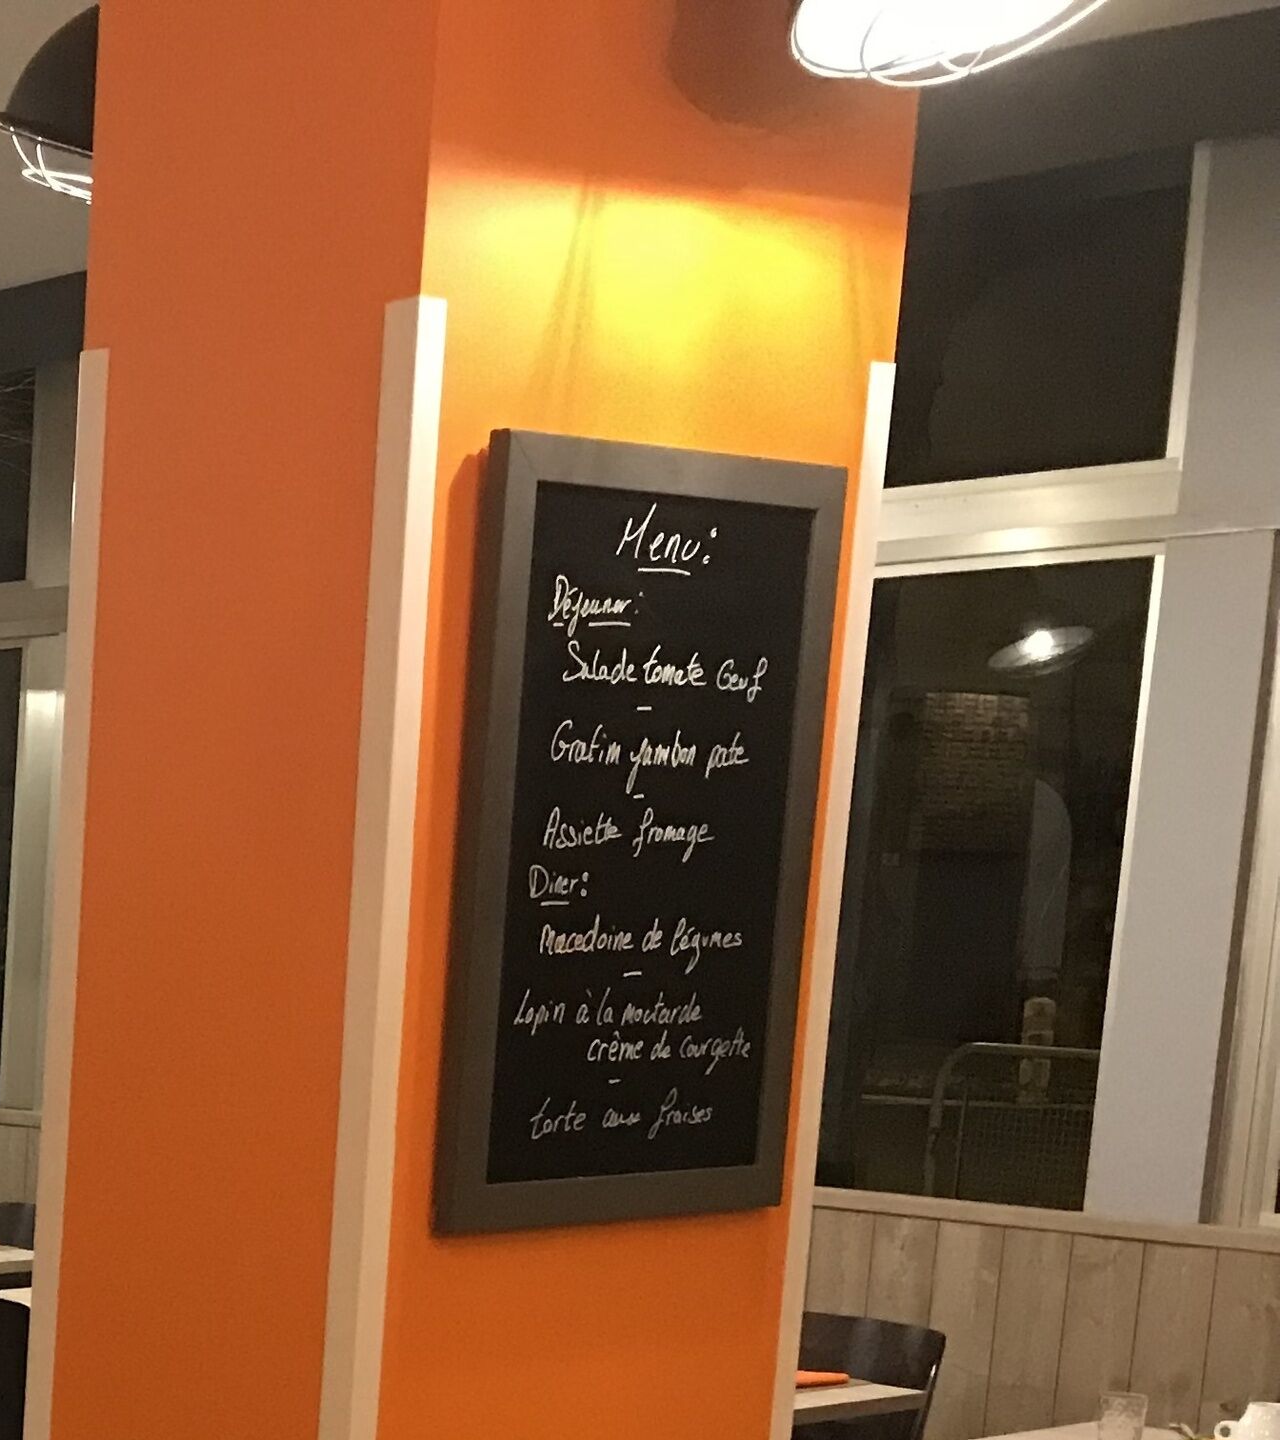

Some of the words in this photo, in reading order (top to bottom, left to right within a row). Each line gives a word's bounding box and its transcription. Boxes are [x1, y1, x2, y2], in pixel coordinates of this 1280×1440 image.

[562, 640, 638, 685] Salade
[643, 644, 707, 686] tomate
[550, 719, 621, 765] Gratin
[625, 729, 697, 794] jambon
[542, 806, 623, 850] Assiette
[632, 807, 716, 863] fromage
[642, 918, 663, 953] de
[576, 989, 592, 1024] à
[596, 987, 614, 1026] la
[650, 1029, 671, 1061] de
[647, 1087, 713, 1140] fraises
